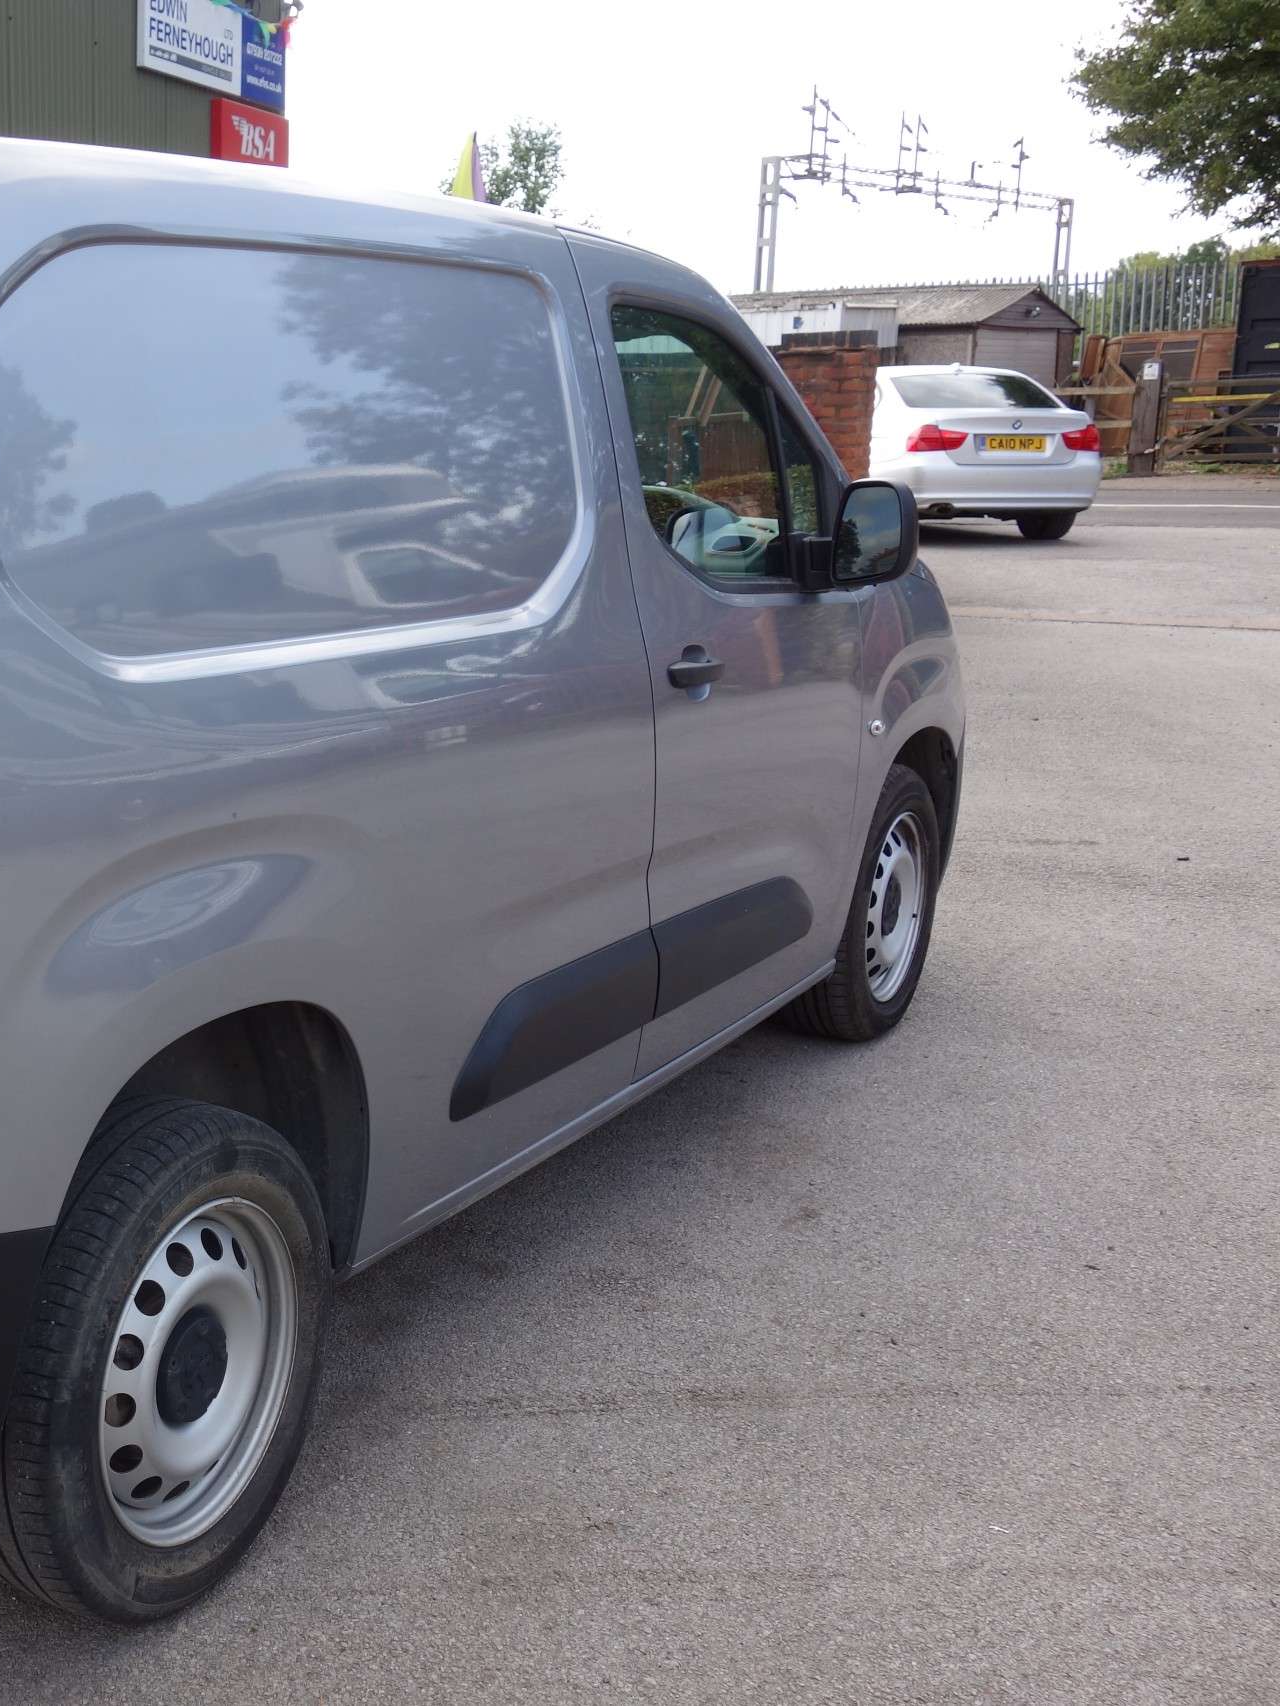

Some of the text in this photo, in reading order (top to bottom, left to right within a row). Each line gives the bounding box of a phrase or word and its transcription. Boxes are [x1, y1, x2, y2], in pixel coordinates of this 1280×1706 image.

[149, 17, 234, 67] FERNEYHOUGH
[240, 122, 276, 162] BSA
[989, 438, 1042, 450] CA10 NPJ
